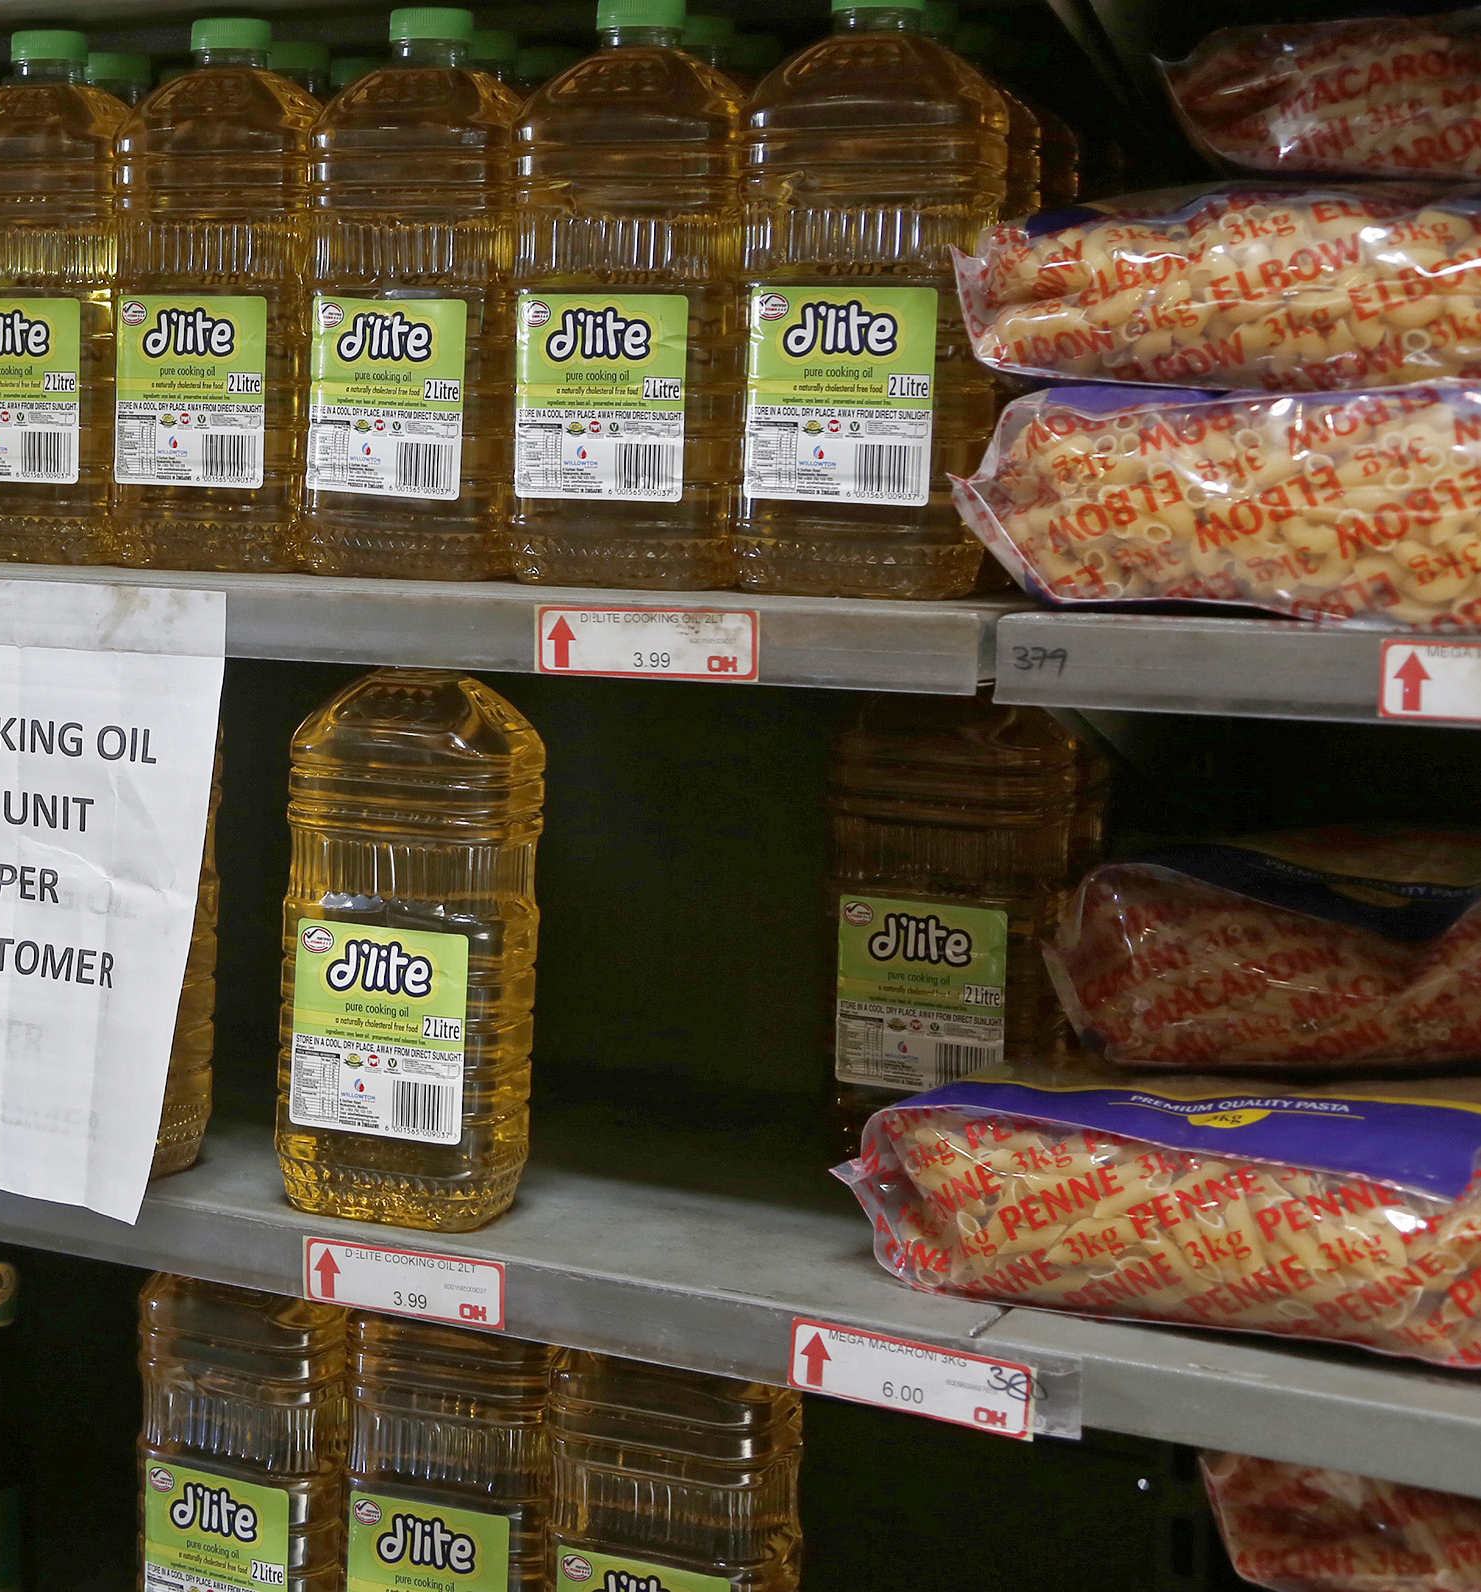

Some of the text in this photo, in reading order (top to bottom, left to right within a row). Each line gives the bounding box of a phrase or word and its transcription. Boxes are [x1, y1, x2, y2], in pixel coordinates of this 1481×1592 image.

[1226, 210, 1296, 245] 3kg
[1386, 220, 1455, 246] 3kg
[1210, 232, 1361, 312] ELBOW
[143, 307, 234, 358] d'lite
[337, 311, 432, 362] d'lite
[546, 307, 651, 362] d'lite
[783, 300, 897, 357] d'lite
[1131, 298, 1199, 335] 3kg
[1264, 307, 1337, 347] 3kg
[160, 366, 215, 378] pure cooking oil
[229, 375, 260, 392] 2 Litre
[425, 381, 458, 399] 2 Litre
[644, 380, 680, 399] 2 Litre
[804, 367, 873, 380] pure cooking oil
[889, 376, 928, 396] 2 Litre
[1048, 470, 1184, 554] ELBOW
[1194, 465, 1346, 553] ELBOW
[624, 613, 679, 624] COOKING
[683, 613, 700, 624] OIL
[704, 614, 724, 624] 2LT
[633, 652, 671, 668] 3.99
[1427, 646, 1471, 658] MEGA
[97, 724, 157, 765] OIL
[3, 789, 94, 833] UNIT
[868, 912, 972, 967] d'lite
[326, 939, 432, 997] d'lite
[345, 1002, 409, 1018] pure cooking oil
[424, 1018, 460, 1039] 2 Litre
[296, 1034, 463, 1062] STORE IN A COOL, DRY PLACE, AWAY FROM DIRECT SUNLIGHT.
[1130, 1094, 1350, 1113] PREMIUM QUALITY PASTA
[1010, 1141, 1072, 1175] 3kg
[998, 1164, 1124, 1241] PENNE
[1127, 1166, 1265, 1239] PENNE
[1255, 1182, 1403, 1242] PENNE
[385, 1253, 434, 1269] COOKING
[440, 1260, 455, 1271] OIL
[458, 1262, 476, 1274] 2LT
[1062, 1225, 1126, 1266] 3kg
[1184, 1227, 1252, 1271] 3kg
[1318, 1233, 1390, 1273] 3kg
[393, 1291, 427, 1309] 3.99
[1186, 1254, 1315, 1320] PENNE
[1313, 1252, 1447, 1328] PENNE
[828, 1329, 967, 1368] MEGA MACARONI 3KG
[882, 1381, 924, 1404] 6.00
[170, 1482, 257, 1542] d'lite
[377, 1513, 476, 1574] d'lite
